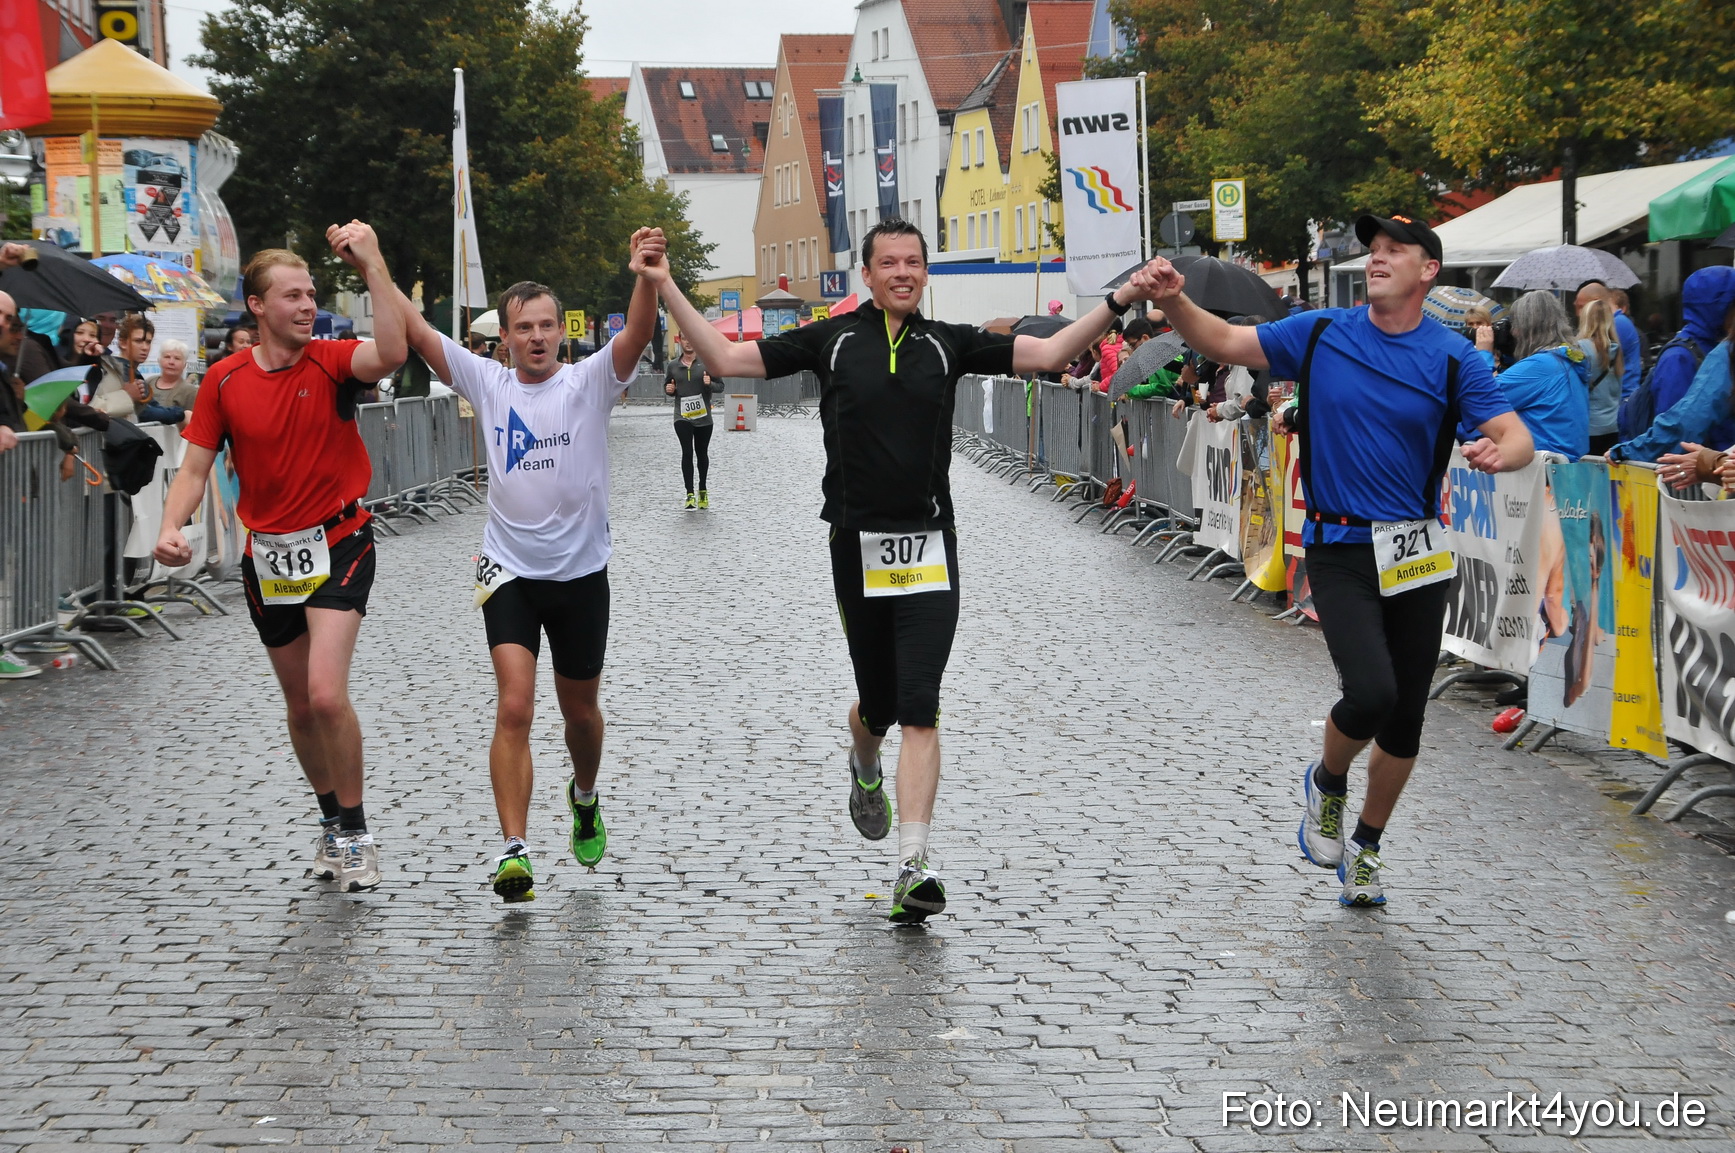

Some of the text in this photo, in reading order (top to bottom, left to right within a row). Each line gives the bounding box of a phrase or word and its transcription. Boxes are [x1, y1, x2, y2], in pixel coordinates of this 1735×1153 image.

[877, 138, 896, 188] K&L
[970, 188, 986, 207] HOTEL
[813, 307, 828, 315] Block
[571, 319, 580, 332] D
[685, 401, 702, 412] 308
[515, 457, 555, 471] Team
[253, 537, 312, 549] PARTL Neumarkt
[880, 534, 928, 566] 307
[1392, 523, 1433, 563] 321
[265, 548, 314, 577] 318
[889, 572, 923, 585] Stefan
[1396, 561, 1437, 582] Andreas
[274, 581, 317, 594] Alexander
